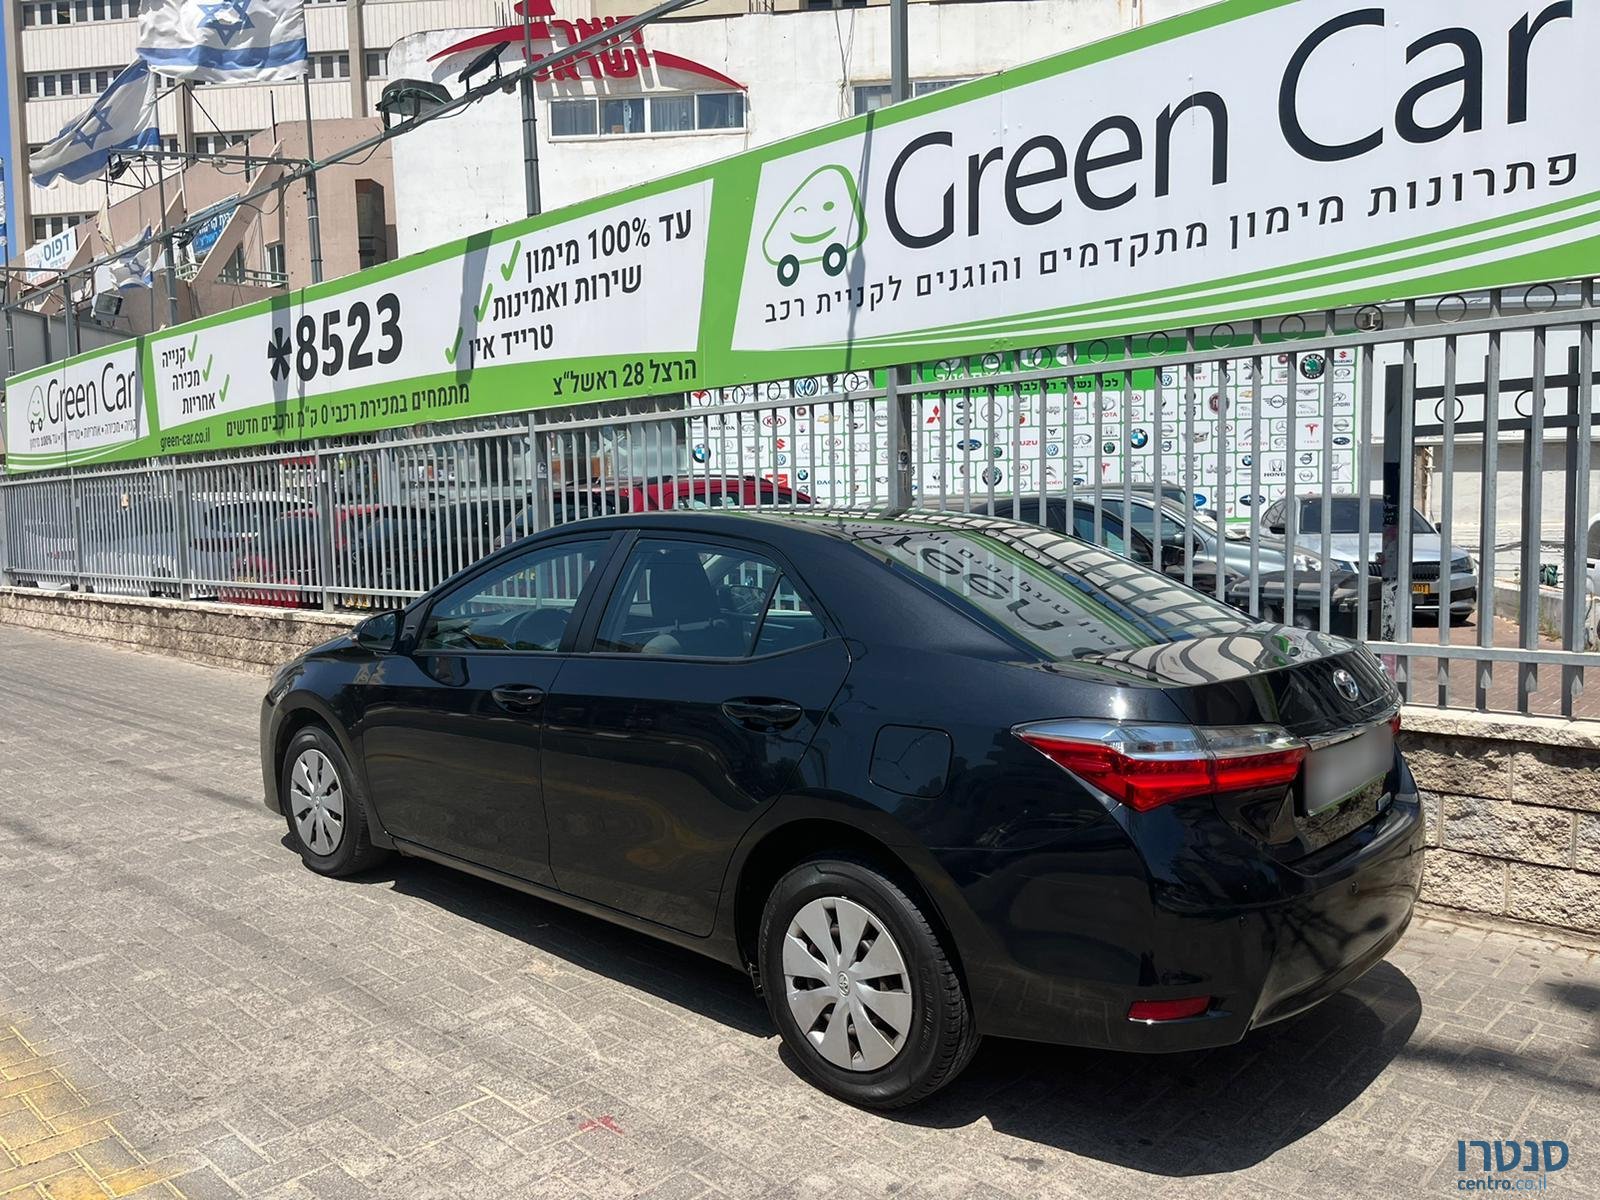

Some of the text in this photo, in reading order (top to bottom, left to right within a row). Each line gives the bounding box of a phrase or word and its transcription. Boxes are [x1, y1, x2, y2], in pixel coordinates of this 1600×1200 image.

[885, 0, 1573, 250] Green Car
[43, 233, 70, 262] דפוס
[525, 209, 692, 283] עד 100% מימון
[764, 153, 1577, 323] פתרונות מימון מתקדמים והוגנים לקניית רכב
[492, 264, 642, 322] שירות ואמינות
[162, 347, 186, 369] קנייה
[469, 324, 554, 370] טרייד אין
[172, 369, 200, 391] מכירה
[622, 362, 645, 387] 28
[650, 359, 697, 384] הרצל
[47, 362, 135, 424] Green Car
[182, 392, 216, 415] אחריות
[412, 383, 469, 411] מתמחים
[321, 404, 328, 425] 0
[331, 403, 356, 423] רכבי
[360, 394, 408, 419] במכירת
[226, 418, 258, 437] חדשים
[261, 412, 294, 432] ורכבים
[160, 427, 210, 450] green-car.co.il
